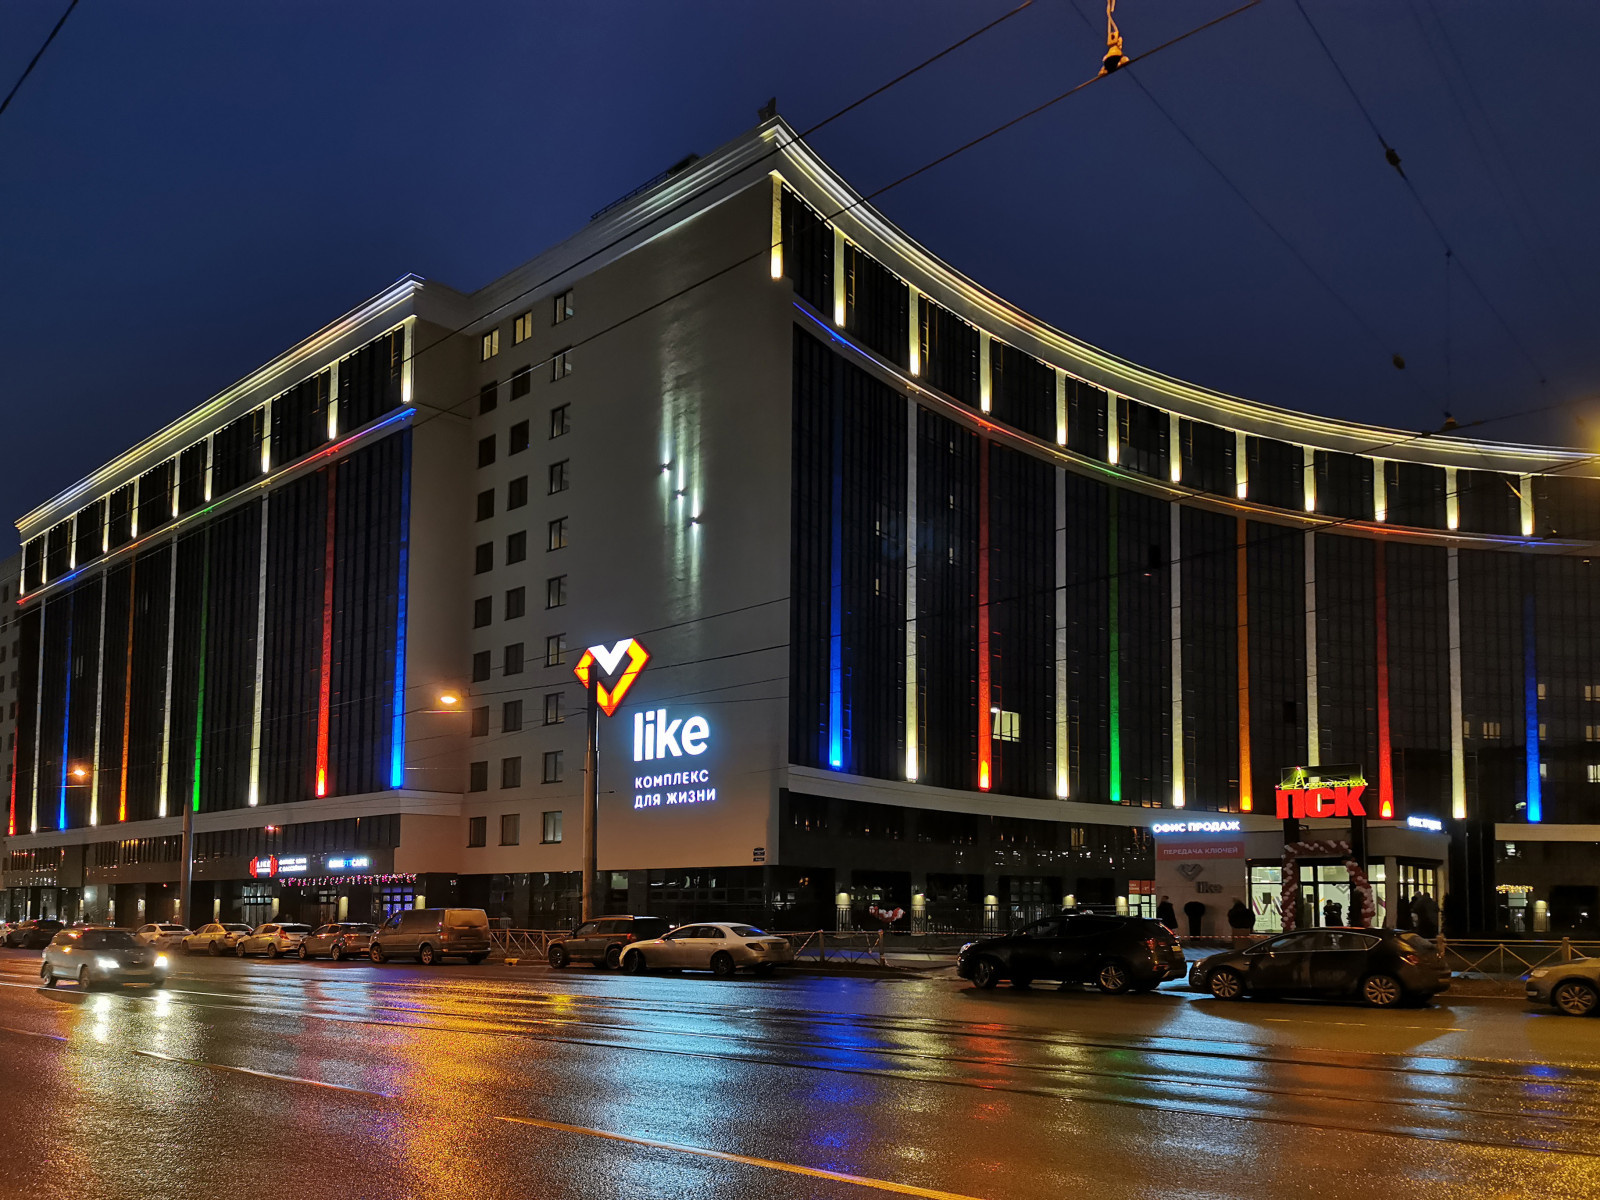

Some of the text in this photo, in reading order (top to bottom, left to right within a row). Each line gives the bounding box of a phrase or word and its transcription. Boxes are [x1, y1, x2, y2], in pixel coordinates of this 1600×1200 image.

[633, 708, 710, 762] like
[634, 769, 709, 789] КОМПЛЕКС
[634, 788, 716, 810] ДЛЯ ЖИЗНИ
[1275, 785, 1367, 819] ПСК
[1152, 821, 1240, 833] ОФИС ПРОДАЖ
[1204, 846, 1238, 854] КЛЮЧЕЙ
